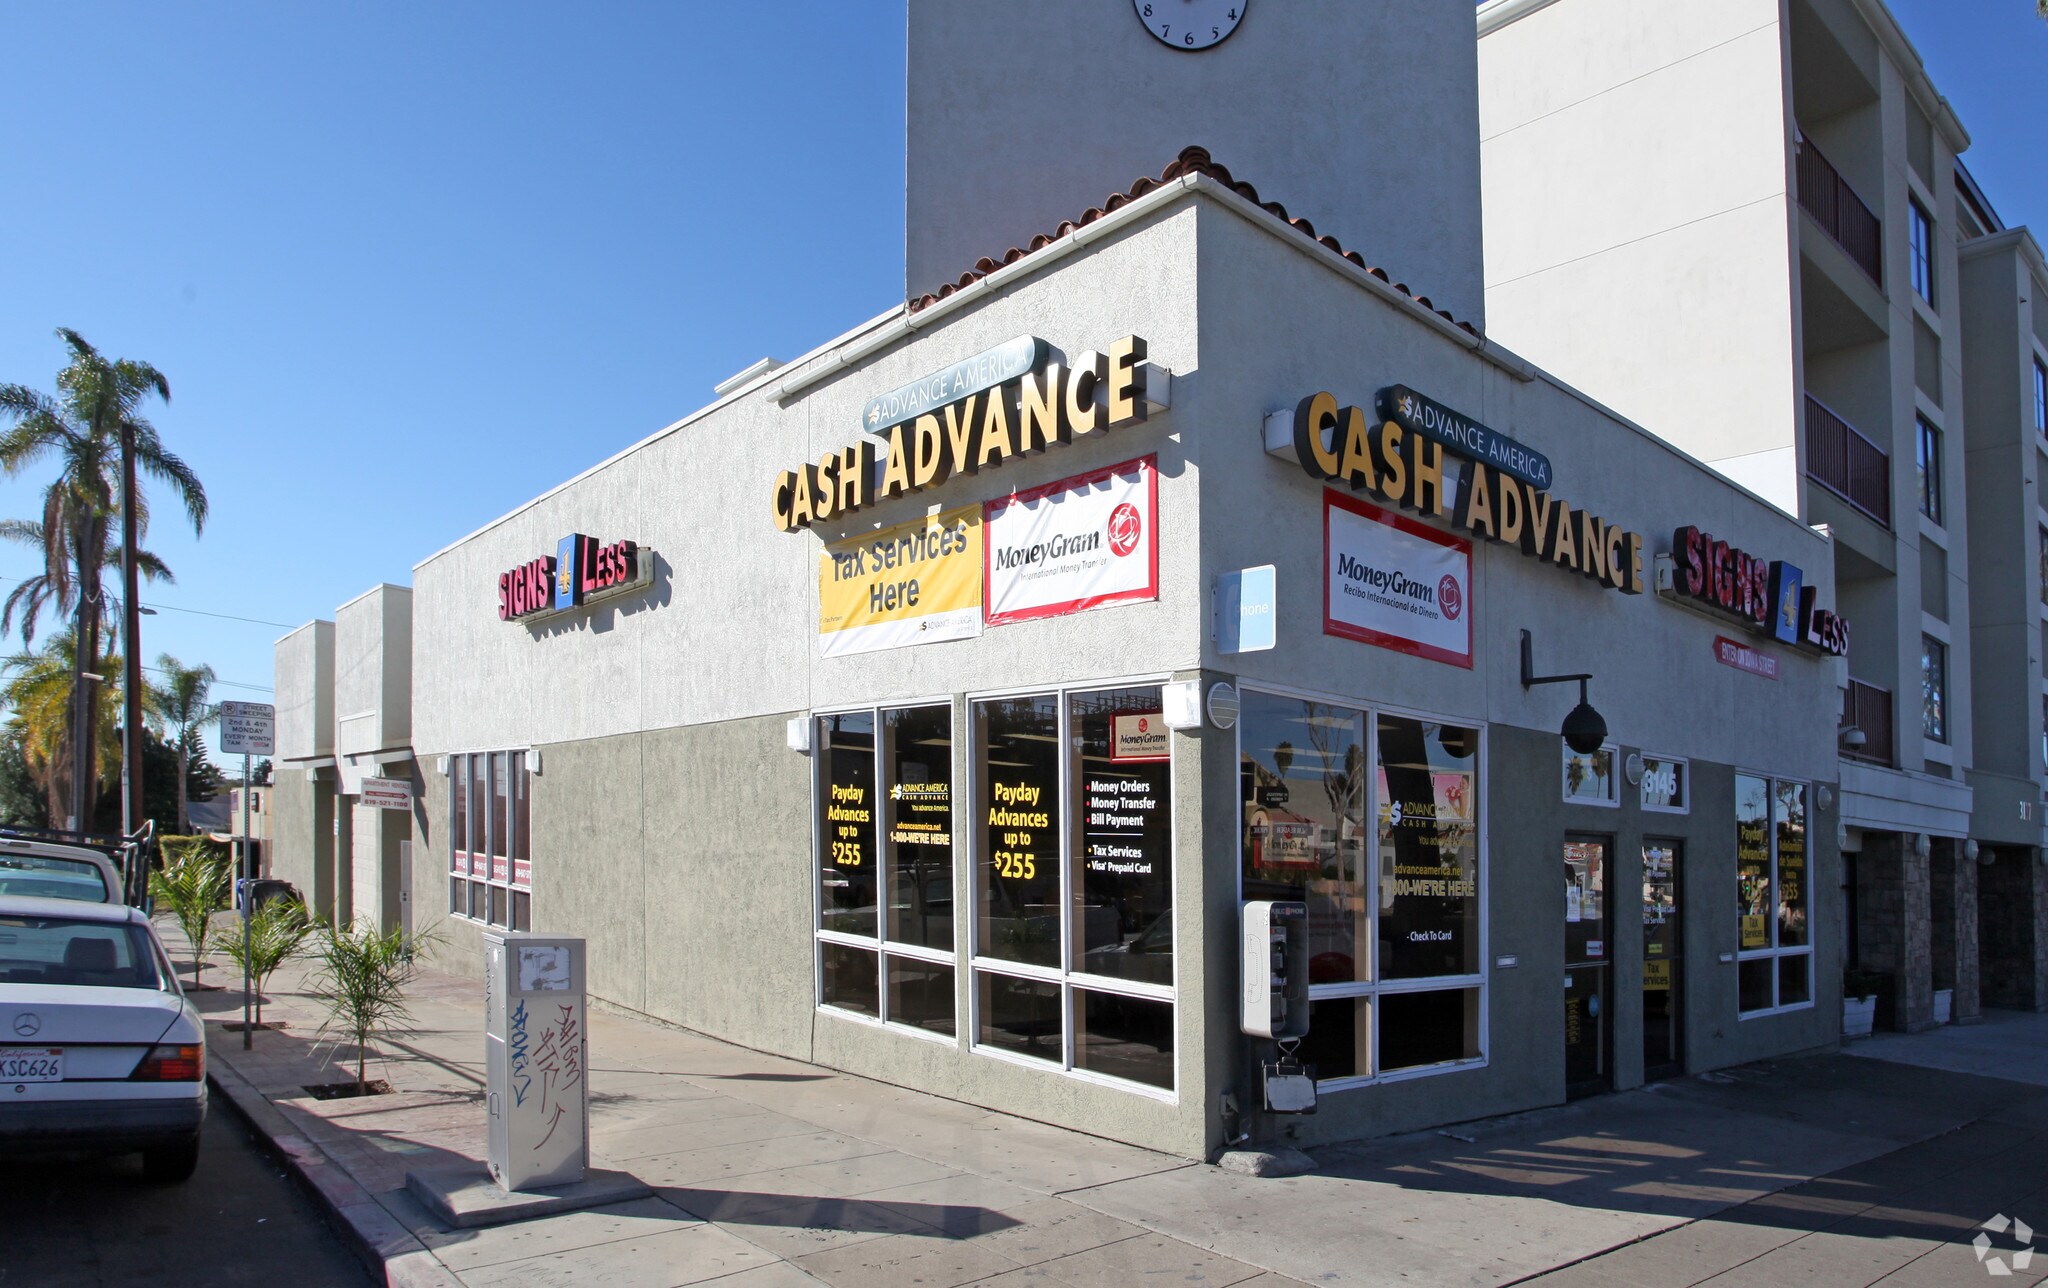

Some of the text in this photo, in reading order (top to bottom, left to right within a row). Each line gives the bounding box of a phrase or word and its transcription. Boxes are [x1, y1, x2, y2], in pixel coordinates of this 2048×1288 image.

[1143, 4, 1153, 17] 8
[1162, 24, 1170, 38] 7
[1184, 32, 1194, 45] 6
[1212, 27, 1219, 40] 5
[880, 346, 1027, 422] ADVANCE AMERICA
[772, 334, 1139, 531] CASH ADVANCE
[1412, 402, 1546, 483] ADVANCE AMERICA
[1304, 391, 1643, 594] CASH ADVANCE
[832, 525, 967, 581] Tax Services
[996, 531, 1099, 571] MoneyGram
[1060, 563, 1080, 574] Money
[1082, 558, 1107, 569] Transer
[498, 555, 550, 621] SIGNS
[557, 547, 571, 596] 4
[1338, 553, 1433, 603] MoneyGram
[1684, 525, 1768, 622] SIGNS
[1781, 579, 1797, 630] 4
[870, 578, 919, 613] Here
[1344, 583, 1438, 620] Recibo Internacional de Dinero
[1759, 655, 1775, 675] STREET
[228, 718, 243, 726] 2nd
[232, 726, 264, 734] MONDAY
[1120, 733, 1166, 745] MoneyGram
[902, 783, 948, 792] ADVANCE AMERICA
[1091, 780, 1150, 795] Money Orders
[1645, 769, 1676, 796] 3145
[832, 784, 864, 804] Payday
[994, 782, 1040, 807] Payday
[1091, 796, 1156, 811] Money Transfer
[1403, 802, 1438, 816] ADVANC
[827, 805, 870, 822] Advances
[988, 807, 1048, 828] Advances
[1091, 813, 1144, 829] Bill Payment
[838, 825, 858, 839] up to
[896, 821, 942, 831] advanceamerica.net
[1402, 820, 1427, 828] CASH
[930, 833, 950, 845] HERE
[1004, 831, 1031, 848] up to
[1741, 825, 1764, 843] Payday
[832, 841, 861, 865] $255
[1092, 844, 1142, 858] Tax Services
[1738, 844, 1768, 860] Advances
[994, 850, 1035, 879] $255
[1107, 861, 1134, 874] Prepaid
[1134, 862, 1152, 873] Card
[1393, 863, 1464, 877] advanceamerica.net
[1381, 879, 1475, 897] 1800-WE'RE HERE
[1749, 917, 1759, 929] Tax
[1410, 930, 1452, 941] Check To Card
[1745, 929, 1763, 939] Services
[1647, 963, 1660, 974] Tax
[1643, 974, 1668, 986] ervices
